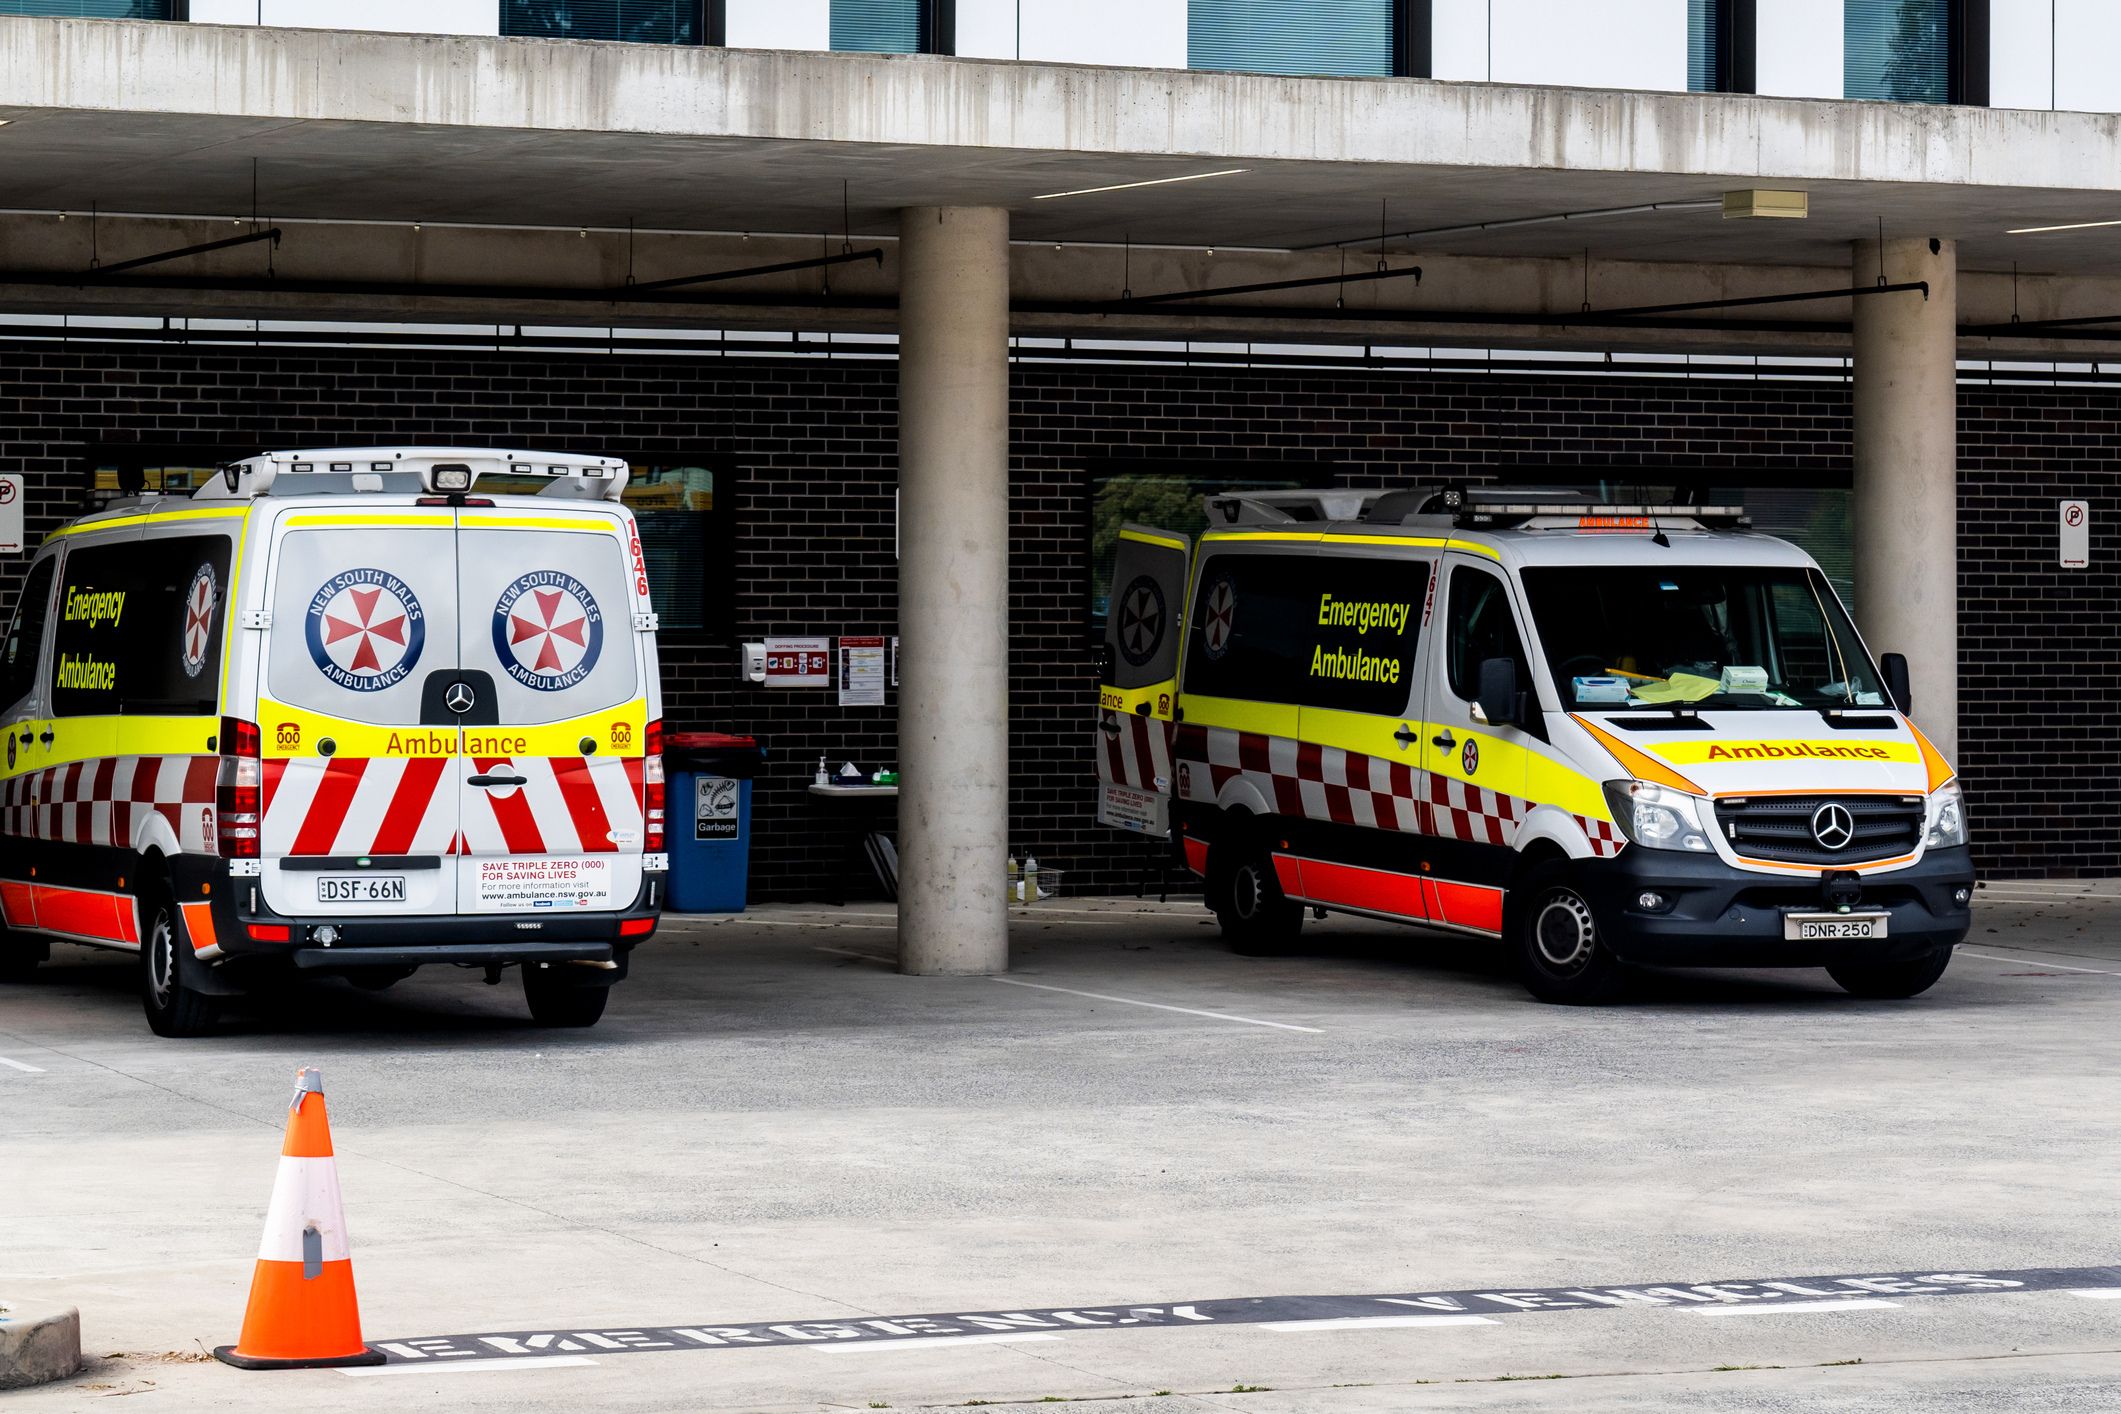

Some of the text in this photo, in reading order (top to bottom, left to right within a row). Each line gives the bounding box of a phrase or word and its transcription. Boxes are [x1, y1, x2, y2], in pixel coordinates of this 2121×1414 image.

[1578, 516, 1649, 528] AMBULANCE
[627, 518, 648, 596] 1646
[309, 570, 422, 621] NEW SOUTH WALES
[496, 572, 601, 623] NEW SOUTH WALES
[1423, 558, 1439, 627] 1647
[65, 586, 126, 629] Emergency
[1318, 593, 1411, 636] Emergency
[56, 652, 116, 690] Ambulance
[508, 663, 589, 689] AMBULANCE
[1310, 644, 1400, 684] Ambulance
[322, 663, 409, 690] AMBULANCE
[276, 731, 300, 744] 000
[386, 731, 527, 754] Ambulance
[611, 731, 631, 743] 000
[1707, 742, 1891, 760] Ambulance
[698, 822, 736, 833] Garbage
[482, 860, 605, 871] SAVE TRIPLE ZERO (000)
[482, 870, 577, 881] FOR SAVING LIVES
[481, 883, 496, 891] For
[523, 881, 570, 890] information
[572, 880, 589, 888] visit
[481, 890, 607, 900] www.ambulance.nsw.gov.au
